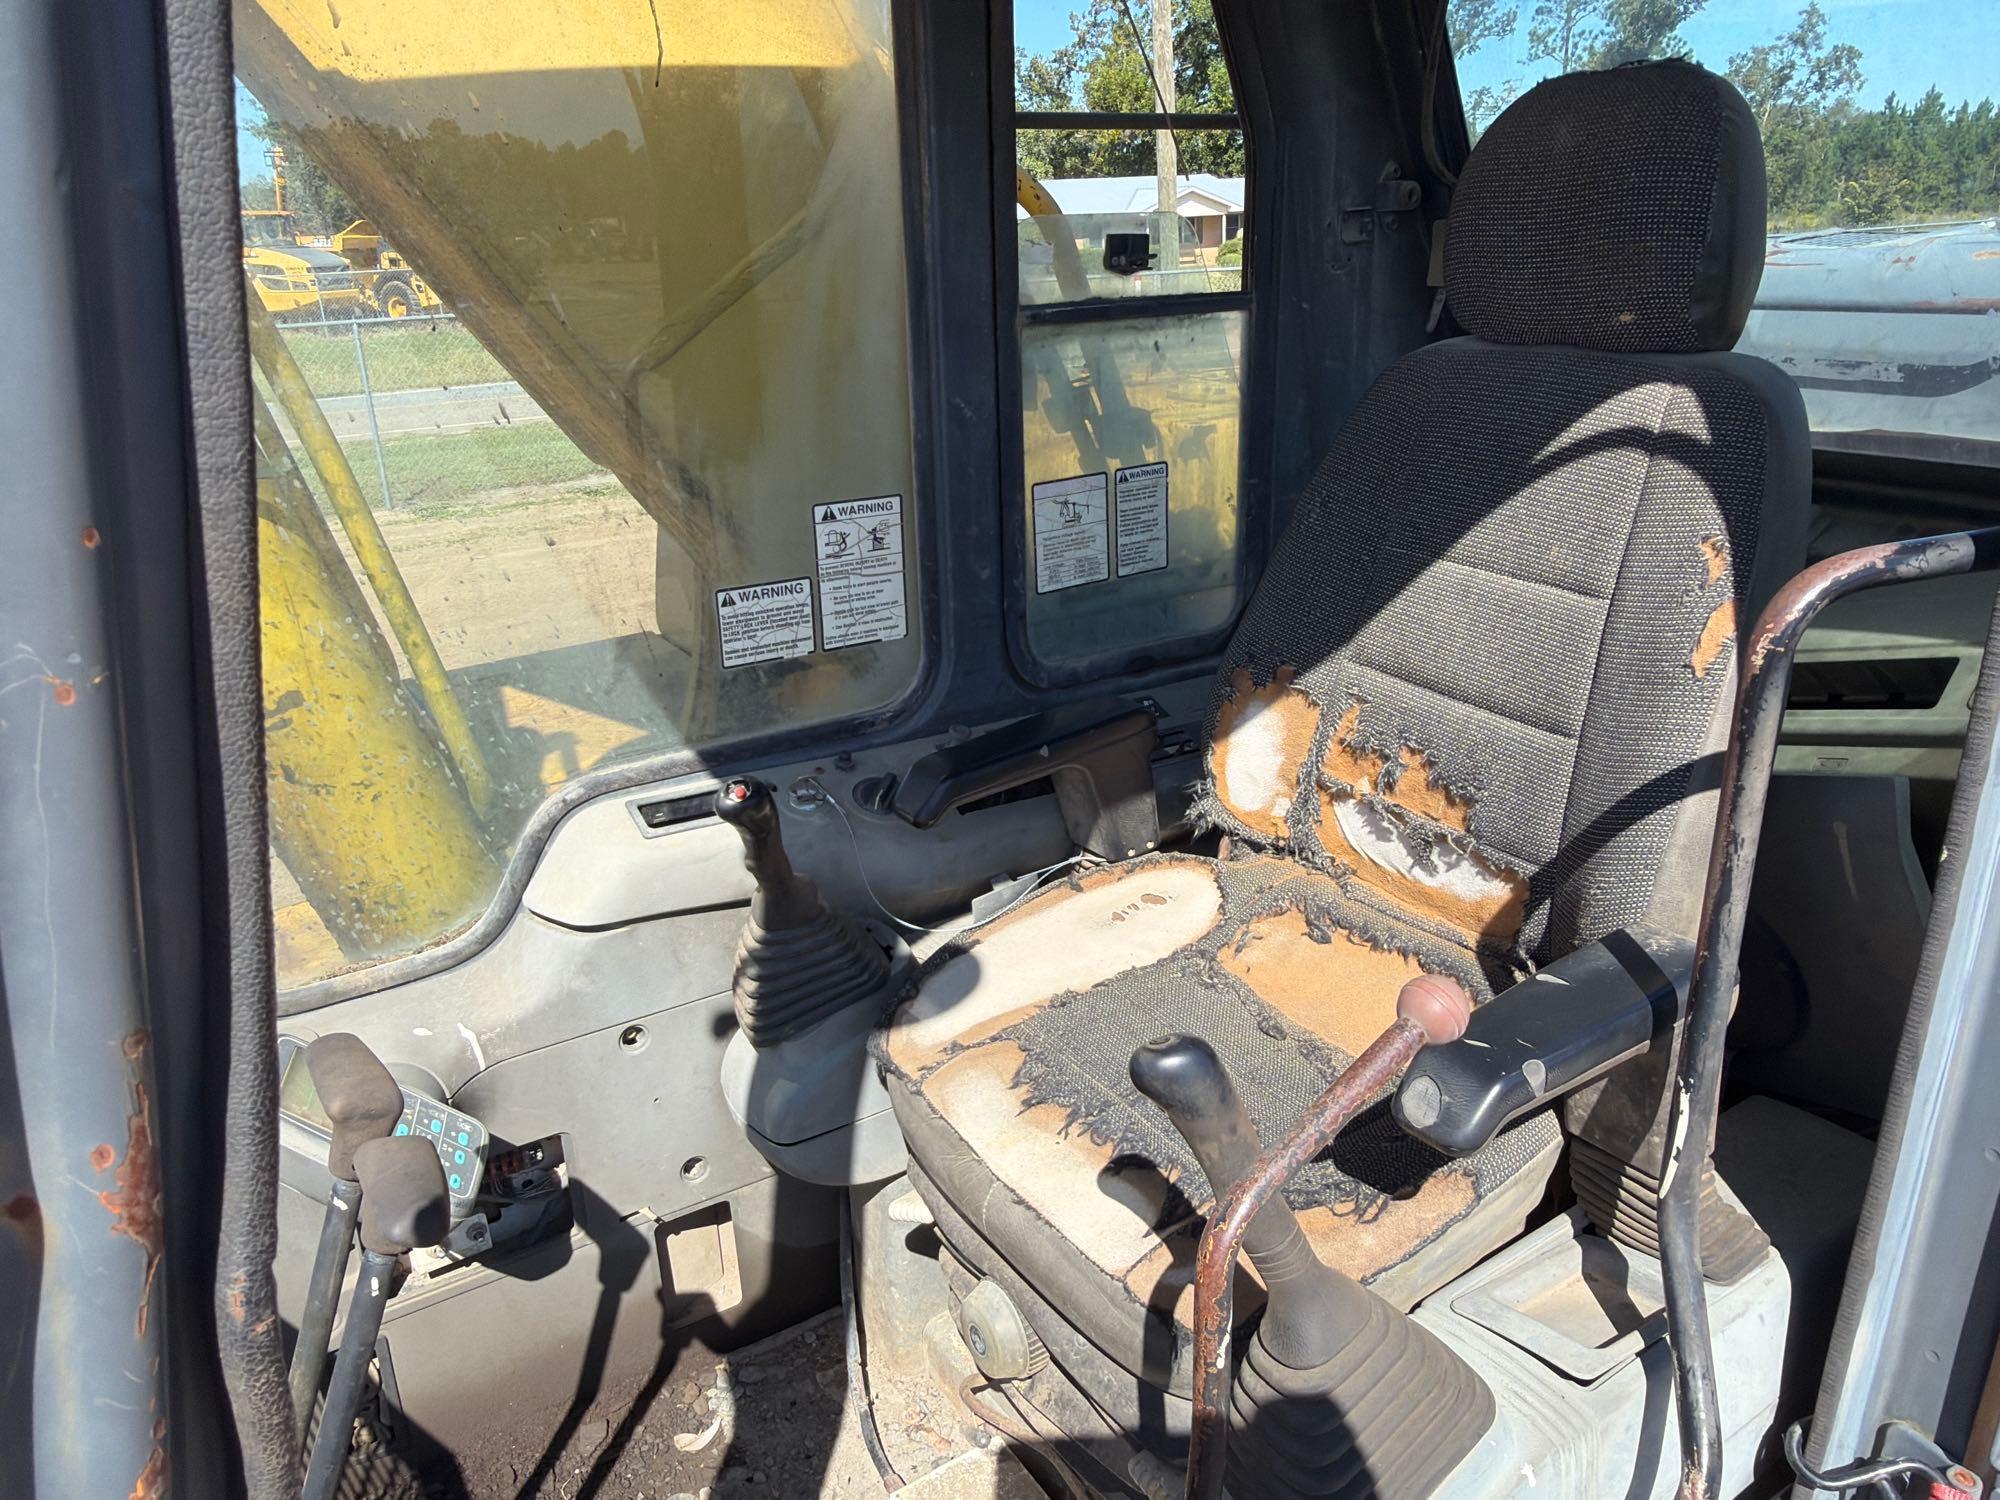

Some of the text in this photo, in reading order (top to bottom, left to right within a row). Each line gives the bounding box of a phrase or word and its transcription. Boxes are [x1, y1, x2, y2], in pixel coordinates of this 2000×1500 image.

[1129, 467, 1164, 480] WARNING
[838, 501, 894, 517] WARNING
[738, 583, 804, 602] WARNING
